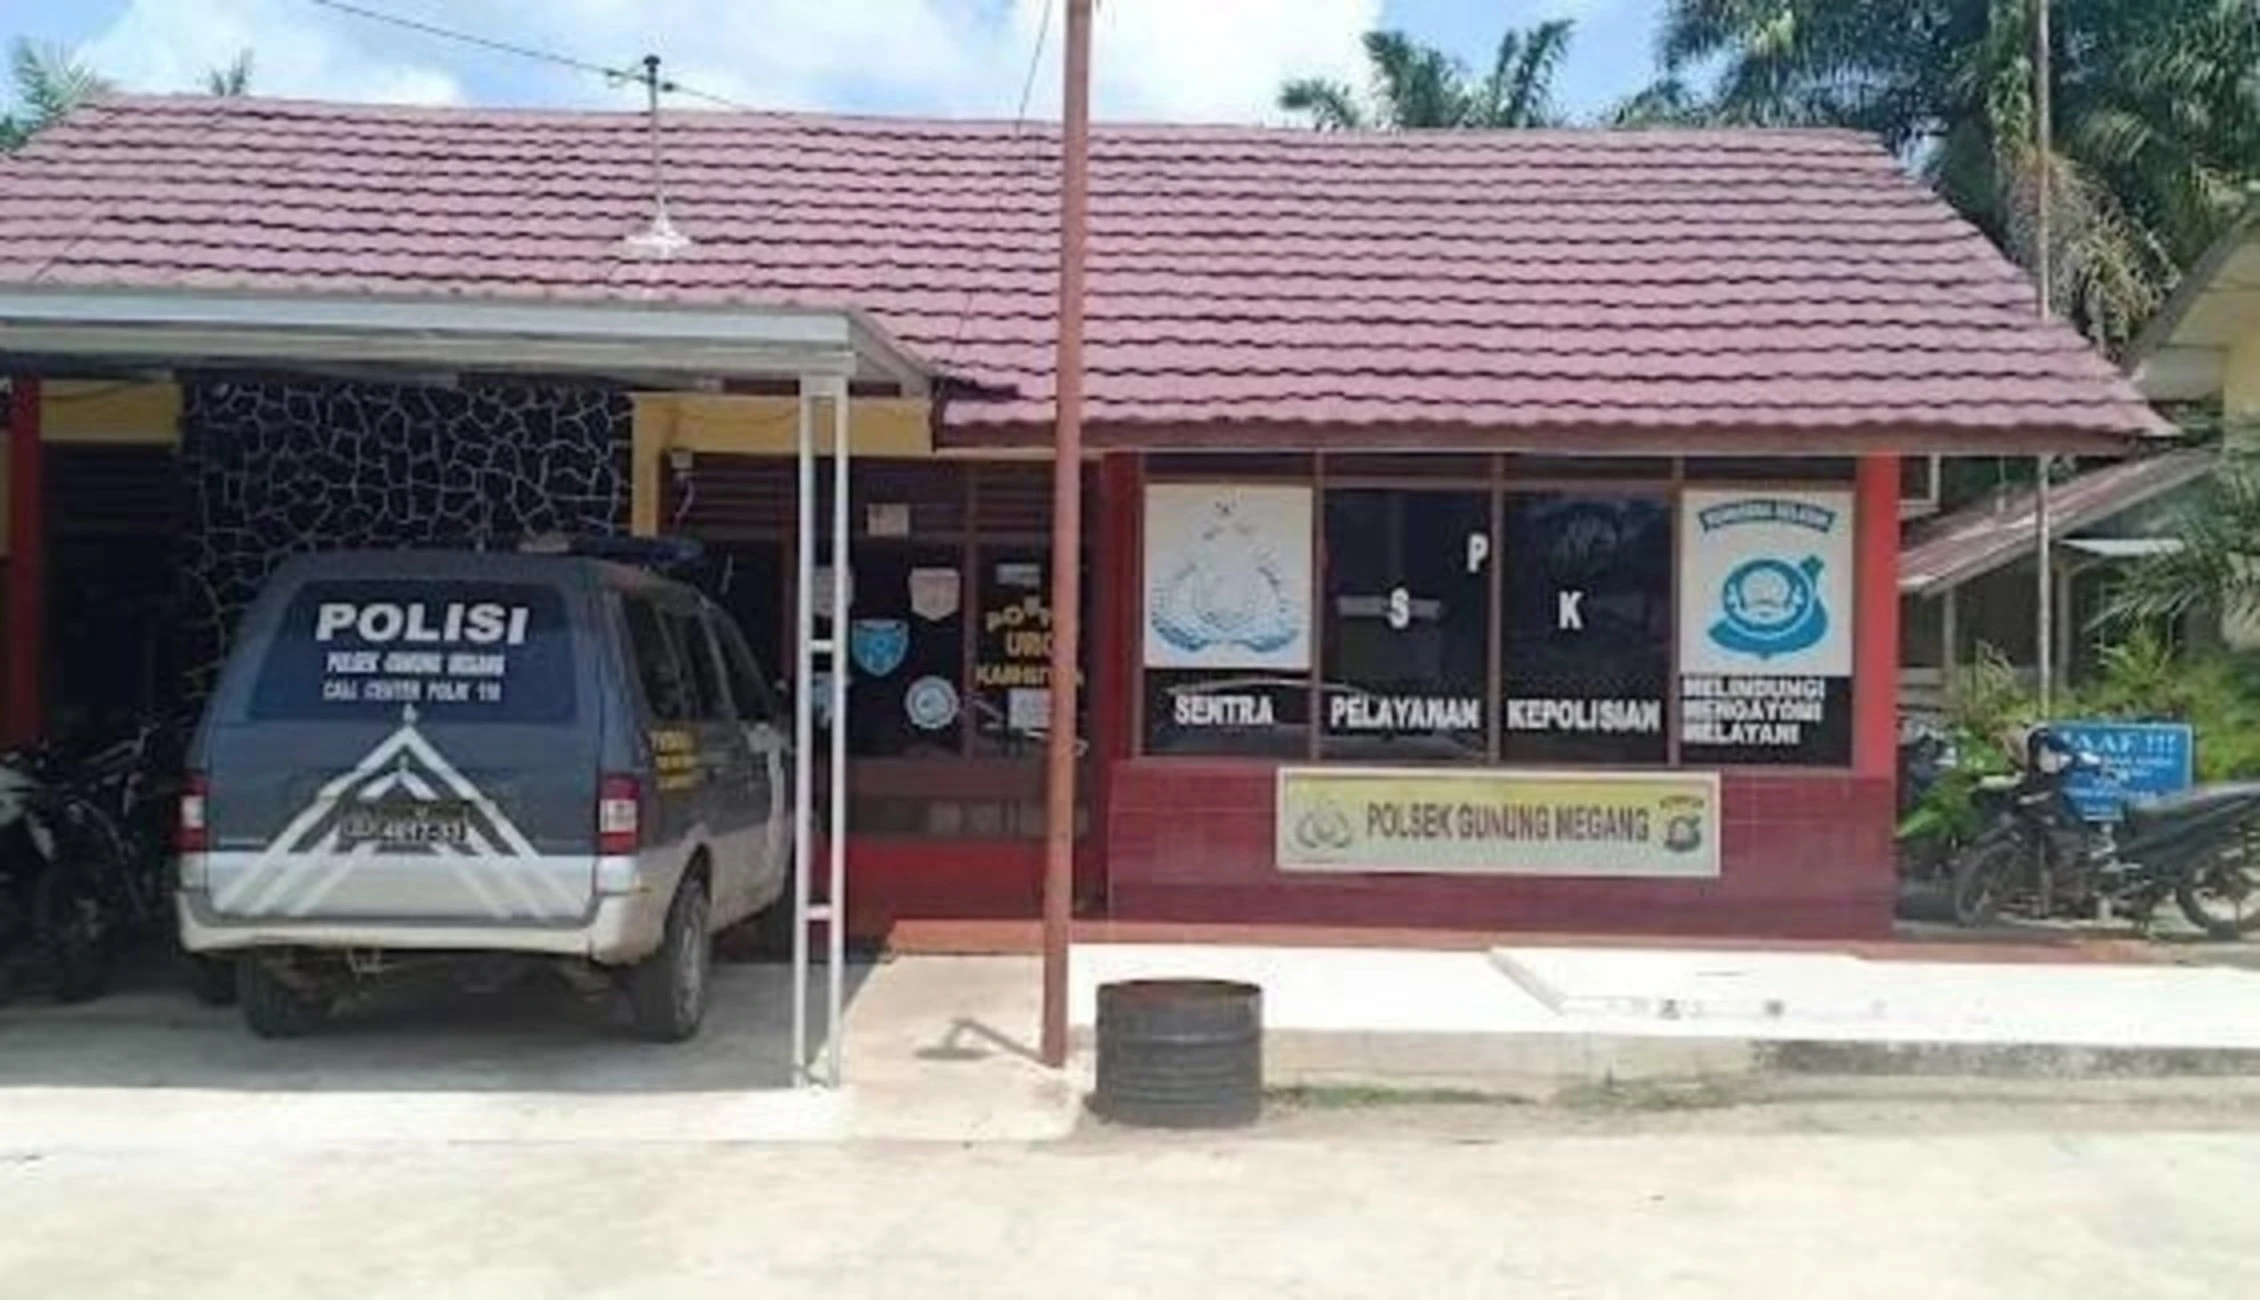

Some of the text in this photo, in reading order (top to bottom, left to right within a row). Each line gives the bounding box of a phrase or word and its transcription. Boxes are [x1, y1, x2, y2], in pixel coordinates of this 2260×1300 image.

[1388, 534, 1584, 629] S P K
[315, 603, 529, 644] POLISI
[1683, 677, 1826, 699] MELINDUNGI
[1174, 695, 1662, 732] SENTRA PELAYANAN KEPOLISIAN
[1683, 722, 1800, 744] MELAYANI
[1366, 801, 1651, 842] POLSEK GUNUNG MEGANG
